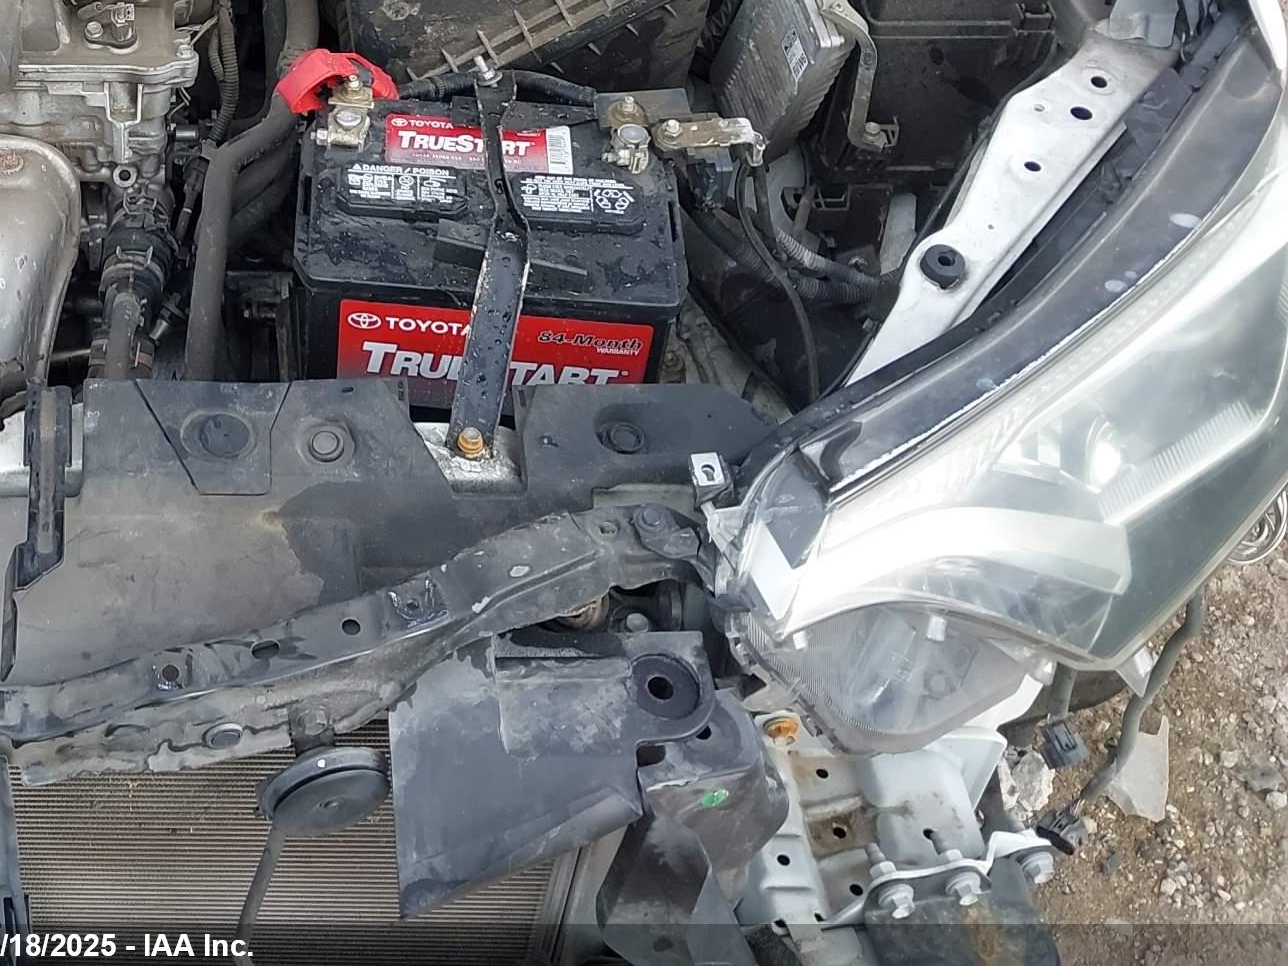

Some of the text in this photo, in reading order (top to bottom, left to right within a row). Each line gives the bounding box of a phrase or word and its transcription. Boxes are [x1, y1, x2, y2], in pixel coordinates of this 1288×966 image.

[409, 121, 454, 129] TOYOTA
[362, 164, 403, 173] DANGER
[537, 330, 643, 350] 84-Month
